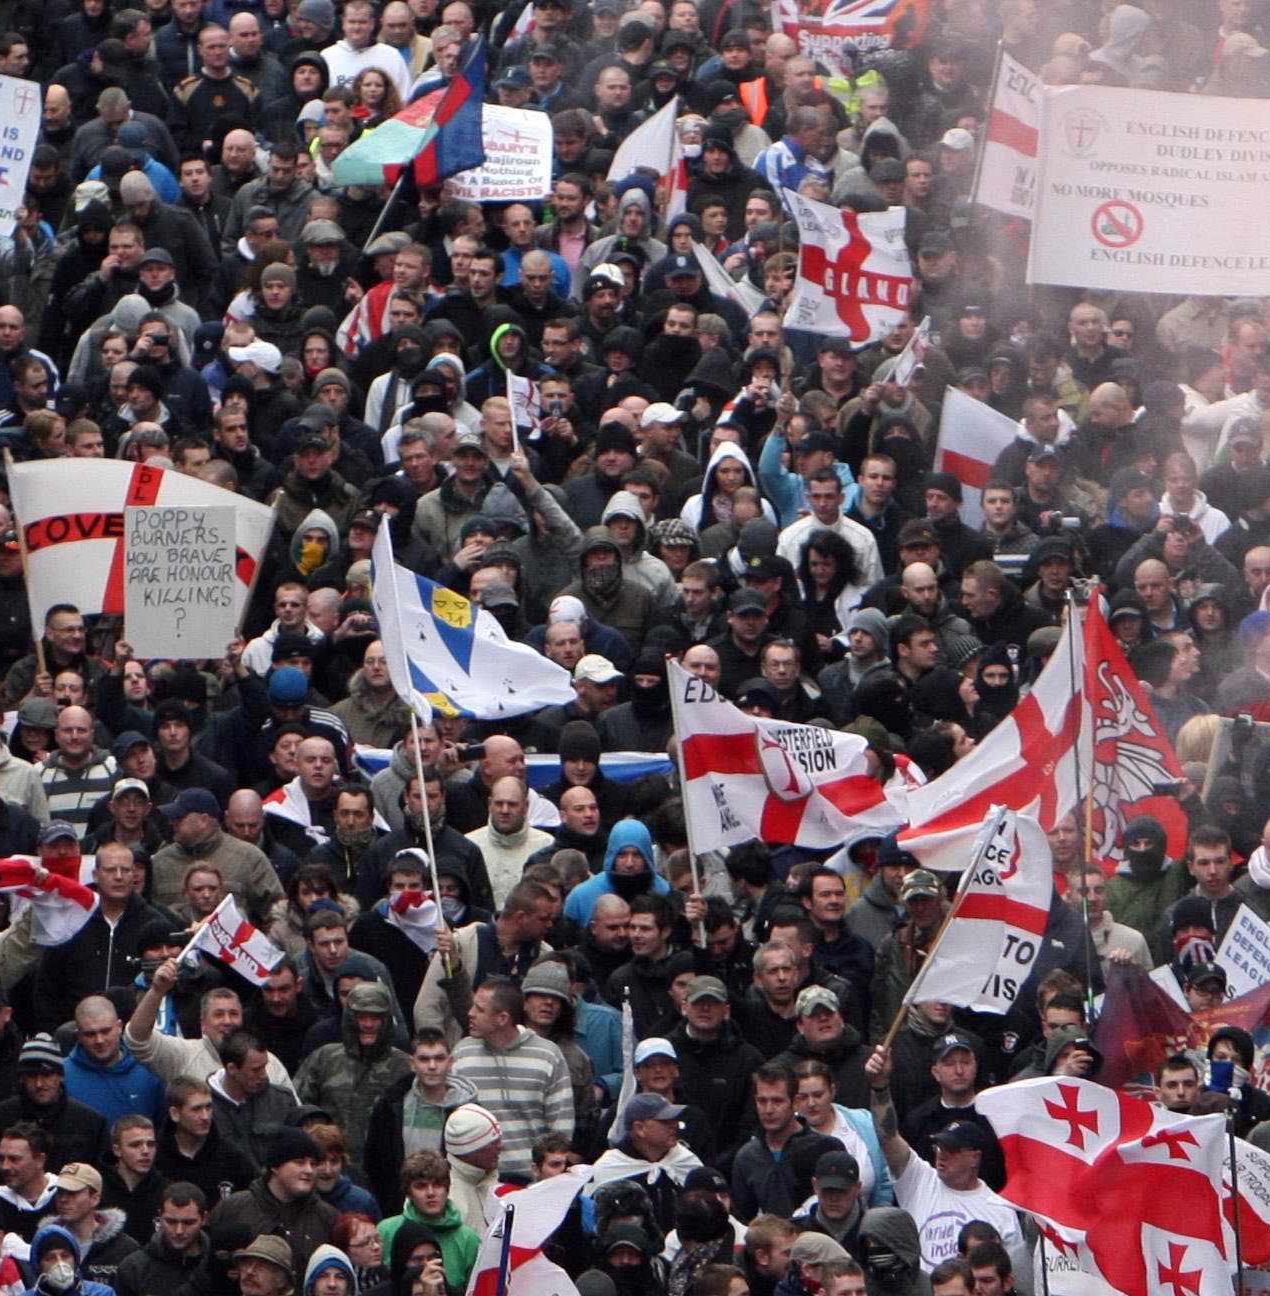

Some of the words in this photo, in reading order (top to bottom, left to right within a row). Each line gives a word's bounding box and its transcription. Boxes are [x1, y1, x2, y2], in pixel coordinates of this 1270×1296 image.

[3, 126, 19, 141] IS
[1126, 121, 1200, 139] ENGLISH
[486, 156, 541, 168] hajiroun
[1157, 144, 1222, 161] DUDLEY
[1089, 160, 1148, 175] OPPOSES
[1151, 166, 1212, 180] RADICAL
[480, 186, 543, 198] RACISTS
[1051, 183, 1072, 196] NO
[1075, 186, 1122, 200] MORE
[1128, 189, 1210, 208] MOSQUES
[1090, 248, 1164, 266] ENGLISH
[1169, 254, 1247, 269] DEFENCE
[135, 509, 205, 530] POPPY
[25, 513, 124, 549] COVE
[126, 551, 157, 566] HOW
[167, 548, 227, 565] BRAVE
[130, 566, 159, 583] ARE
[167, 564, 234, 583] HONOUR
[144, 586, 231, 607] KILLINGS
[1002, 934, 1035, 965] TO
